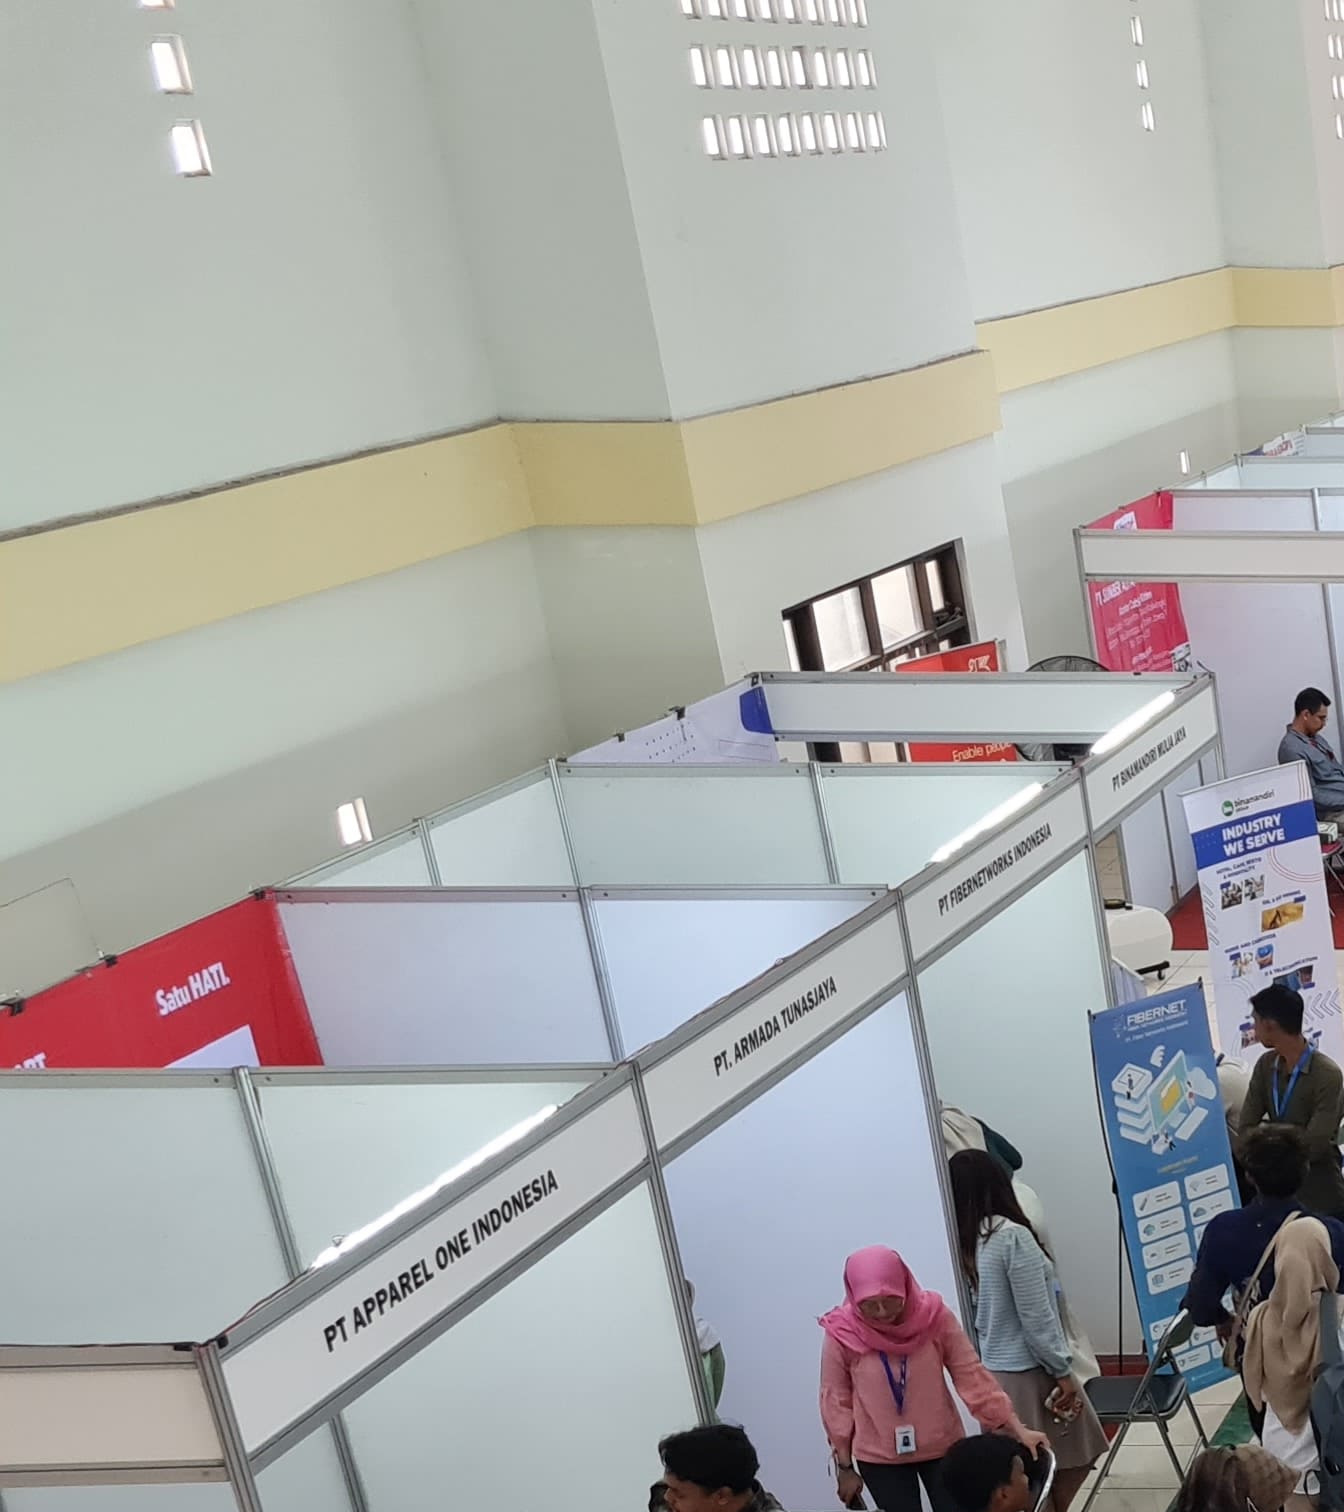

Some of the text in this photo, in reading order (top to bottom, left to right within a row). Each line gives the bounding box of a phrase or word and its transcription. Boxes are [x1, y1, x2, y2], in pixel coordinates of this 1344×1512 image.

[1173, 727, 1187, 747] JAYA
[952, 746, 984, 762] Enable
[1222, 813, 1281, 841] INDUSTRY
[1224, 828, 1285, 856] WE SERVE
[938, 823, 1052, 916] PT FIBERNETWORKS INDONESIA
[156, 962, 231, 1017] Satu HATI.
[714, 975, 837, 1077] PT. ARMADA TUNASJAYA
[1127, 999, 1187, 1026] FIBERNET
[323, 1169, 559, 1352] PT APPAREL ONE INDONESIA
